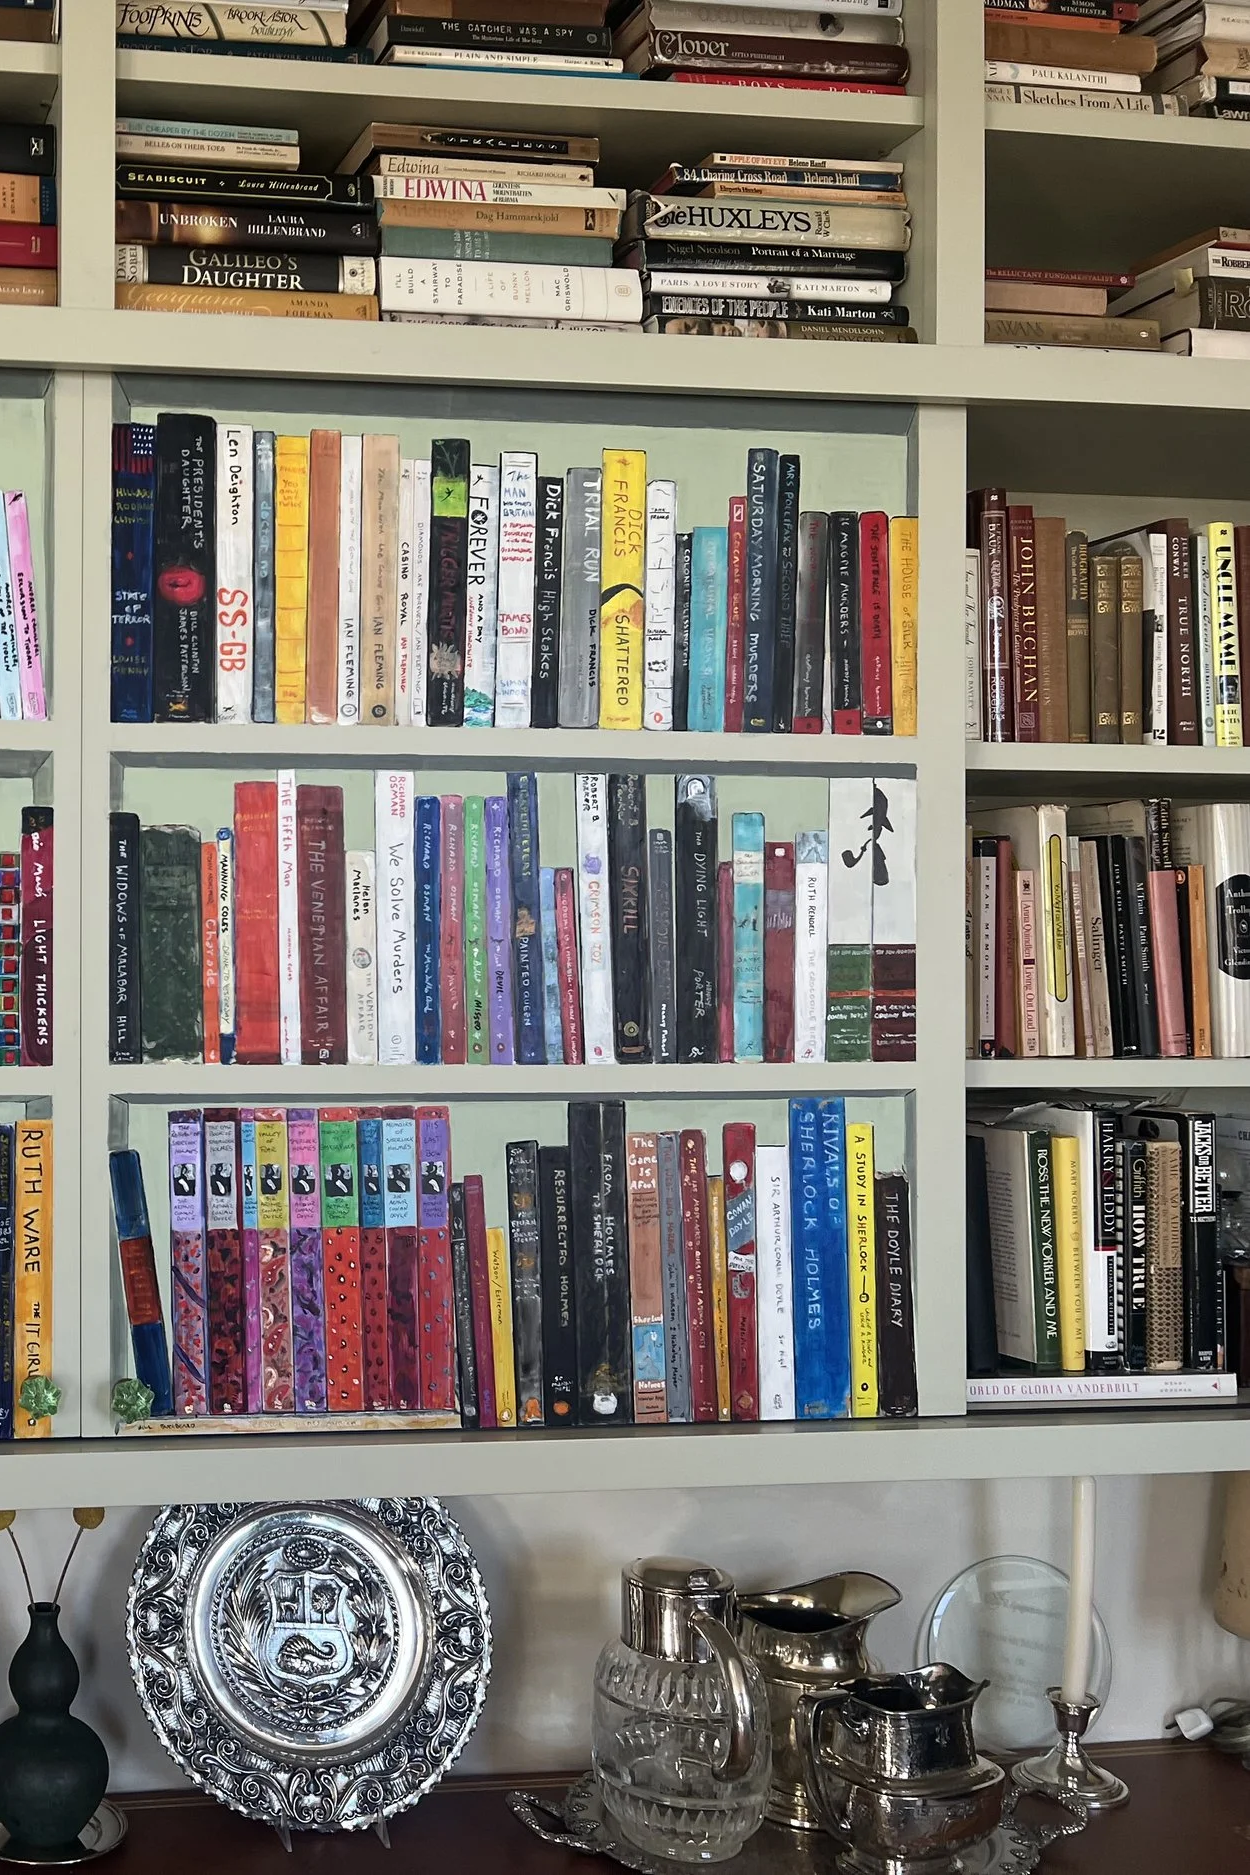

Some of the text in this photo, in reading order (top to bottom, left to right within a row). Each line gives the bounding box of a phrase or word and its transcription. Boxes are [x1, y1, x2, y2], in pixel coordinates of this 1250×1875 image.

[654, 35, 730, 58] Clover
[1032, 69, 1107, 84] PAUL KALANITHI
[1023, 91, 1150, 111] Sketches From A Life
[128, 172, 206, 185] SEABISCUIT
[387, 157, 440, 175] Edwina
[684, 168, 861, 186] 84, Charing Cross Road Helene Hanff
[404, 178, 487, 201] EDWINA
[160, 213, 238, 228] UNBROKEN
[248, 224, 326, 238] HILLENBRAND
[269, 214, 304, 225] LAURA
[476, 210, 559, 222] Dag Hammarskjold
[687, 207, 811, 232] HUXLEYS
[189, 250, 297, 270] GALILEO'S
[751, 247, 788, 257] Portrait
[791, 248, 801, 258] of
[811, 249, 856, 260] Marriage
[182, 265, 304, 290] DAUGHTER
[807, 306, 876, 319] Kati Marton
[226, 430, 239, 525] Len Deighton
[613, 480, 627, 556] FRANCIS
[628, 510, 642, 554] DICK
[537, 484, 561, 679] Dick Francis High Stakes
[747, 462, 766, 704] SATURDAY MORNING MURDERS
[217, 588, 248, 672] SS-GB
[1021, 537, 1037, 703] JOHN BUCHAN
[615, 616, 630, 706] SHATTERED
[1178, 597, 1191, 697] TRUE NORTH
[388, 842, 407, 995] We Solve Murders
[32, 919, 48, 1046] LIGHT THICKENS
[21, 1128, 44, 1273] RUTH WARE
[855, 1135, 868, 1272] A STUDY IN SHERLOCK
[800, 1111, 821, 1330] SHERLOCK HOLMES
[885, 1192, 903, 1328] THE DOYLE DIARY
[1133, 1205, 1145, 1310] HOW TRUE
